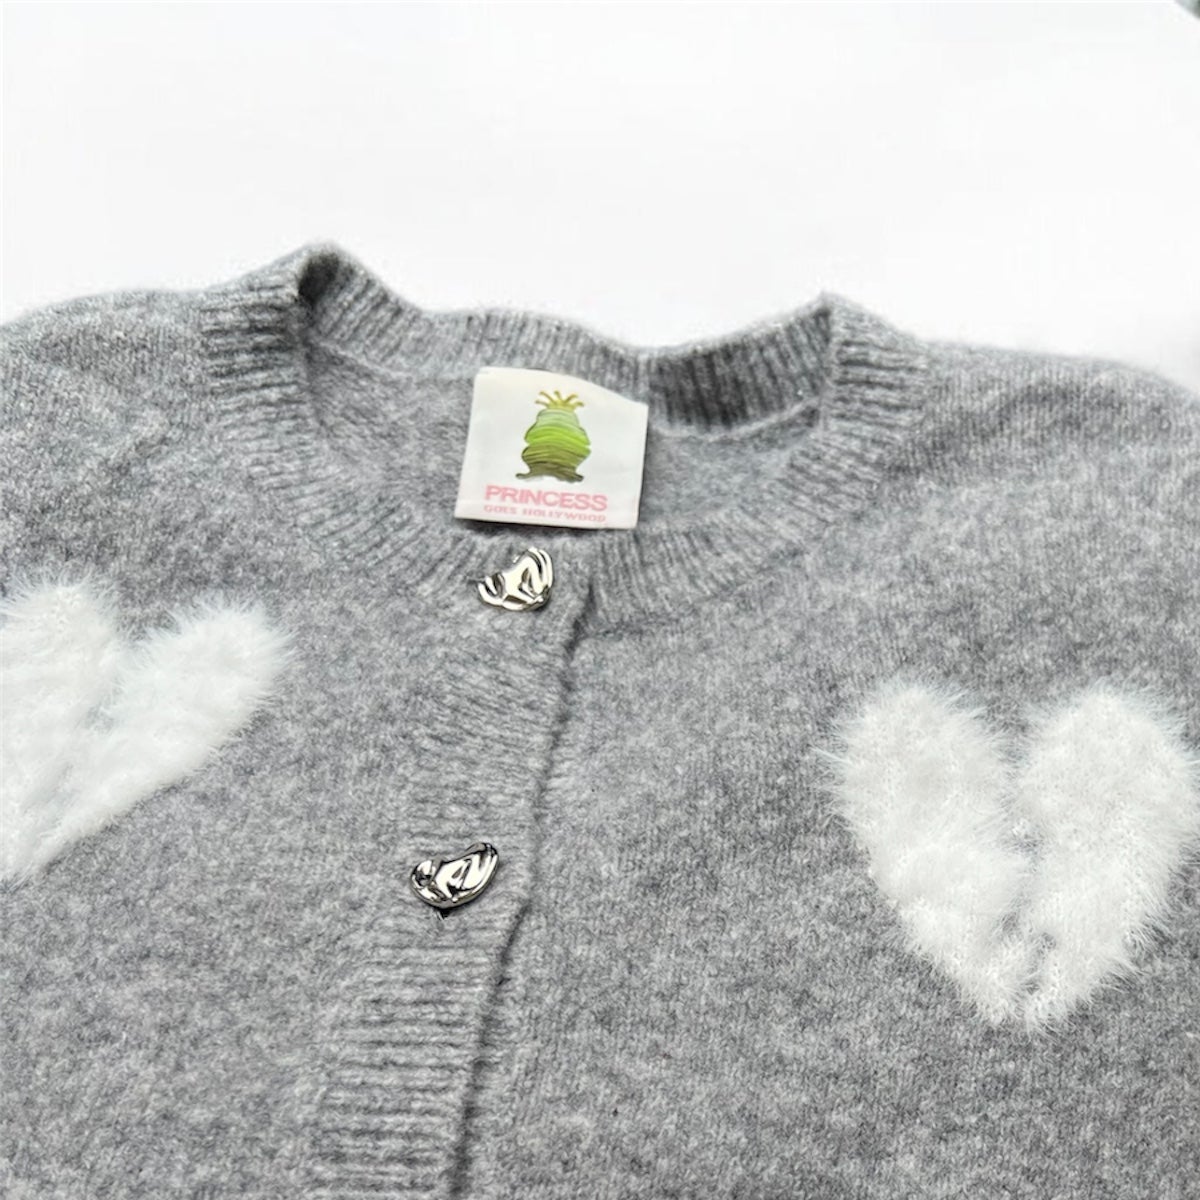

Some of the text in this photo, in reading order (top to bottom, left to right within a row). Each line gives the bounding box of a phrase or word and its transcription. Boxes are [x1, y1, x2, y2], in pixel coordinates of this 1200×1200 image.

[485, 485, 608, 512] PRINCESS
[483, 504, 606, 522] GOES HOLLYWOOD
